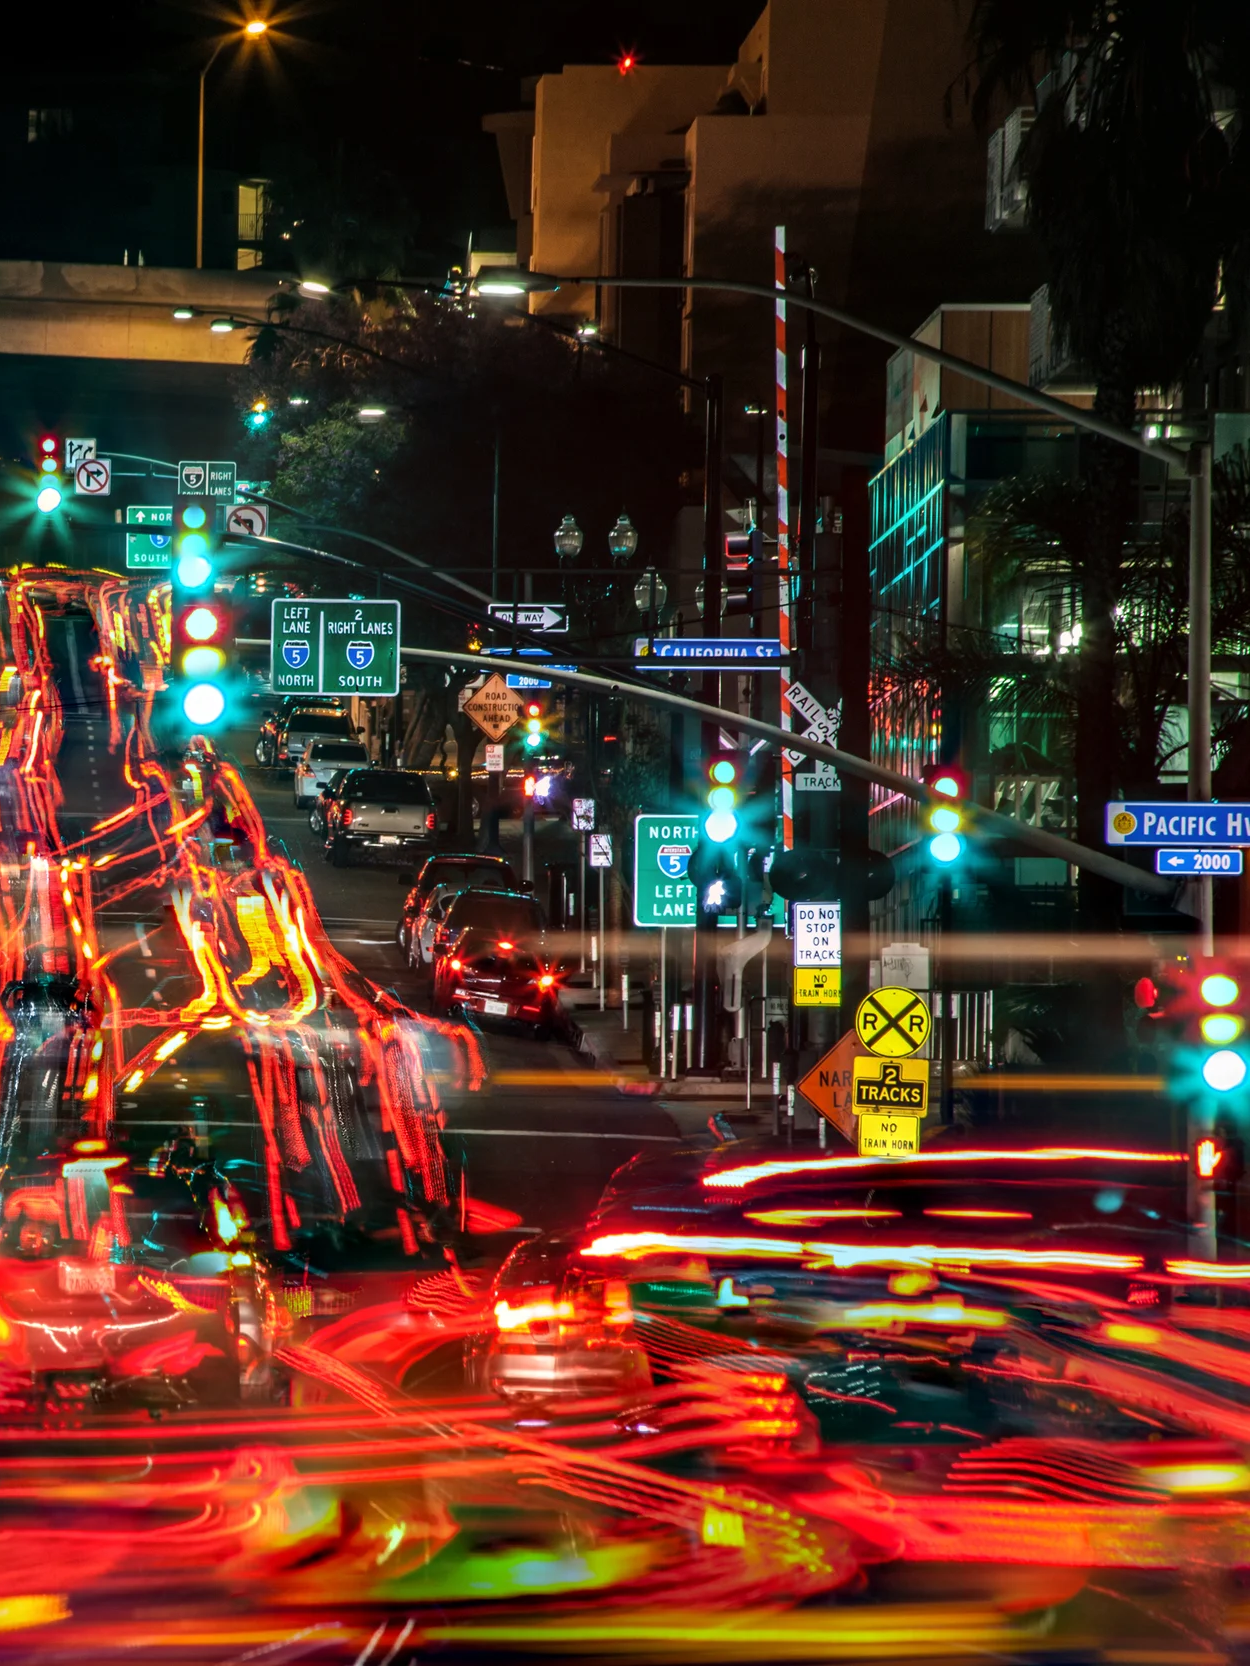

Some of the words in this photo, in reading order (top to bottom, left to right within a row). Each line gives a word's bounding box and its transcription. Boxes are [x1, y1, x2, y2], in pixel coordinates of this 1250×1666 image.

[189, 474, 197, 484] 5
[210, 471, 232, 480] RIGHT
[210, 487, 232, 496] LANES
[151, 513, 172, 521] NOR
[134, 554, 168, 562] SOUTH
[284, 607, 310, 619] LEFT
[354, 609, 363, 620] 2
[524, 614, 544, 622] WAY
[282, 621, 310, 634] LANE
[328, 622, 356, 634] RIGHT
[361, 622, 393, 635] LANES
[292, 649, 300, 664] 5
[356, 650, 364, 665] 5
[278, 674, 314, 686] NORTH
[338, 675, 382, 687] SOUTH
[518, 677, 538, 686] 2000
[485, 692, 507, 700] ROAD
[468, 703, 521, 712] CONSTRUCTIO
[483, 714, 510, 723] AHEAD
[803, 776, 840, 788] TRACK
[1143, 812, 1217, 836] PACIFIC
[669, 855, 681, 873] 5
[1193, 854, 1231, 870] 2000
[655, 885, 694, 898] LEFT
[653, 903, 696, 917] LANE
[799, 910, 815, 919] DO
[819, 909, 841, 919] NOT
[806, 923, 835, 933] STOP
[813, 937, 829, 946] ON
[813, 974, 828, 983] NO
[799, 989, 820, 997] TRAIN
[819, 1070, 852, 1087] NAR
[885, 1068, 897, 1084] 2
[860, 1085, 921, 1103] TRACKS
[881, 1122, 897, 1133] NO
[863, 1137, 887, 1149] TRAIN
[891, 1138, 914, 1150] HORN
